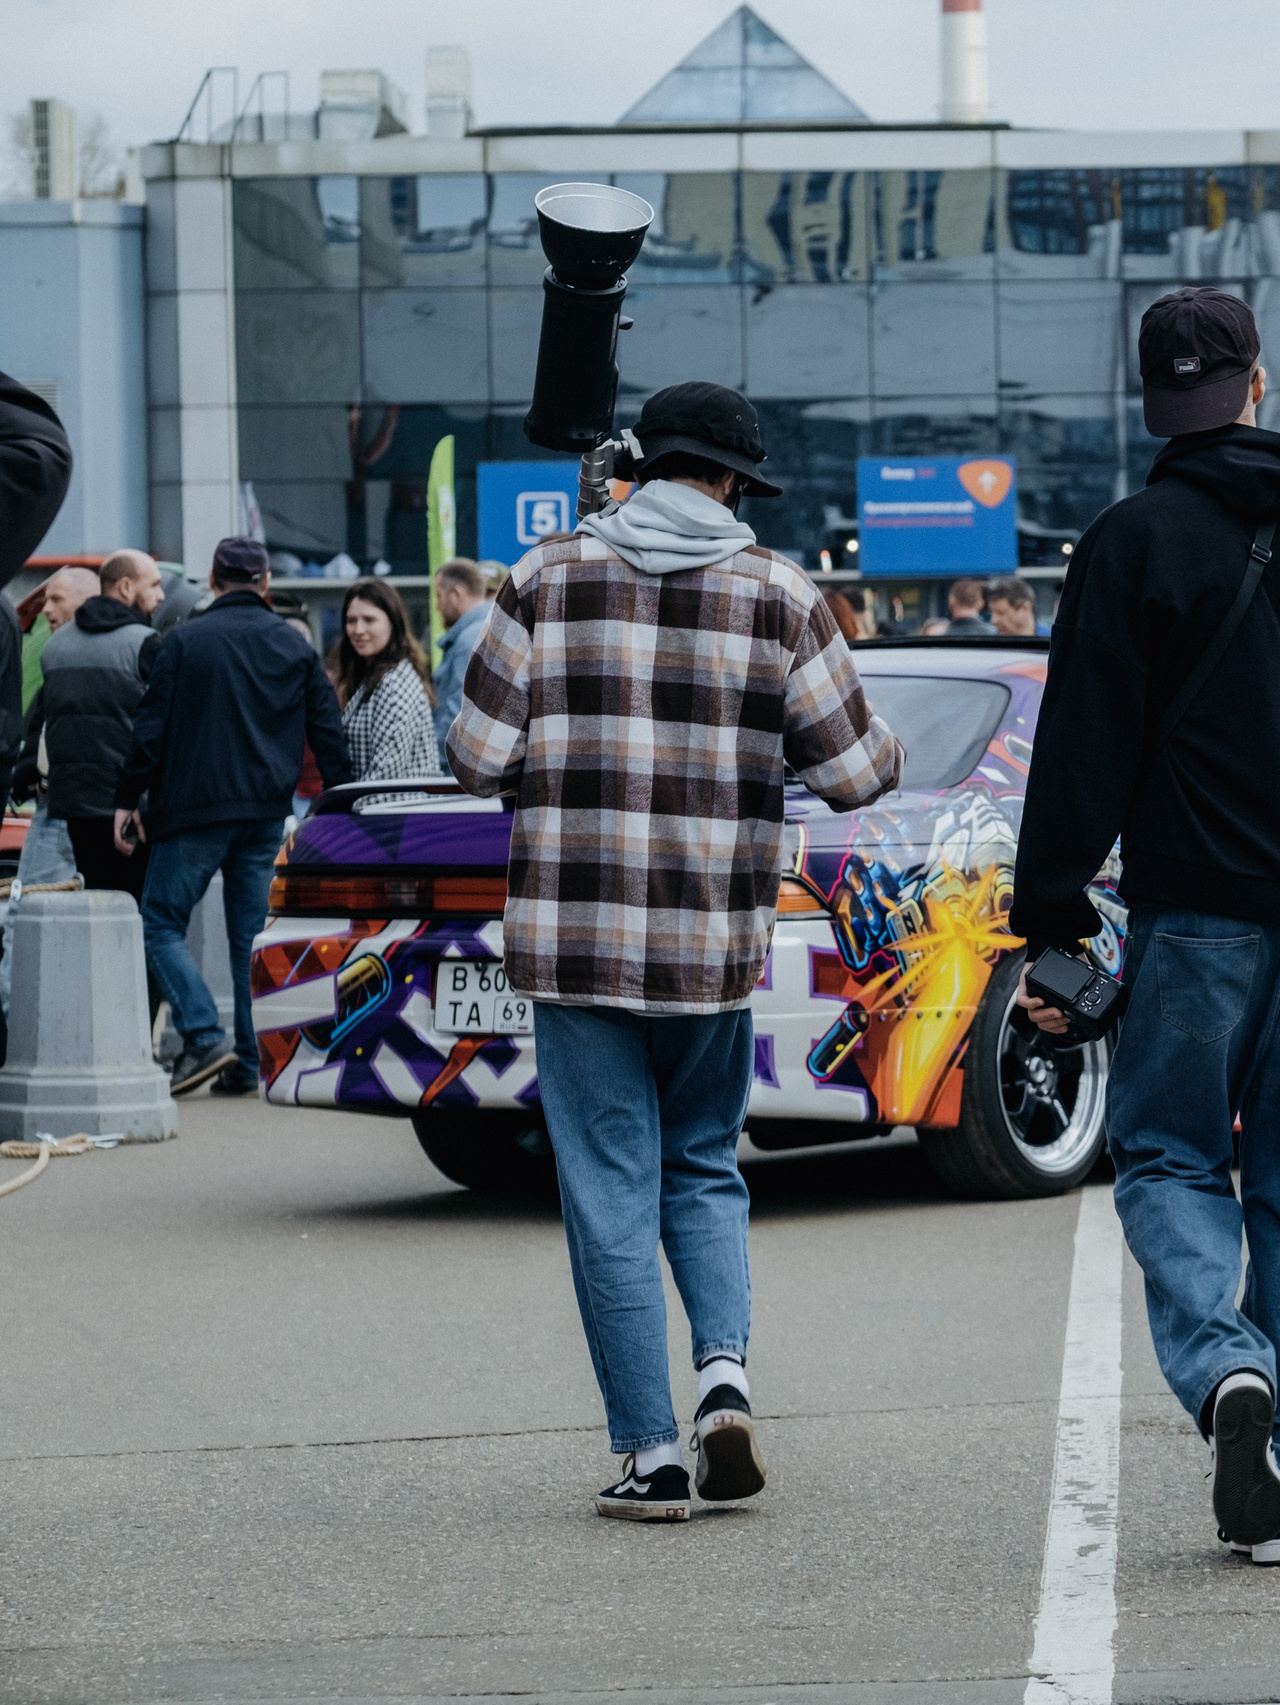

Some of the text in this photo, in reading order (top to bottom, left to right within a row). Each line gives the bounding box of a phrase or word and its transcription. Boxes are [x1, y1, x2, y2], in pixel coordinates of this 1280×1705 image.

[531, 501, 558, 536] 5
[479, 964, 515, 992] 60
[502, 1001, 527, 1021] 69
